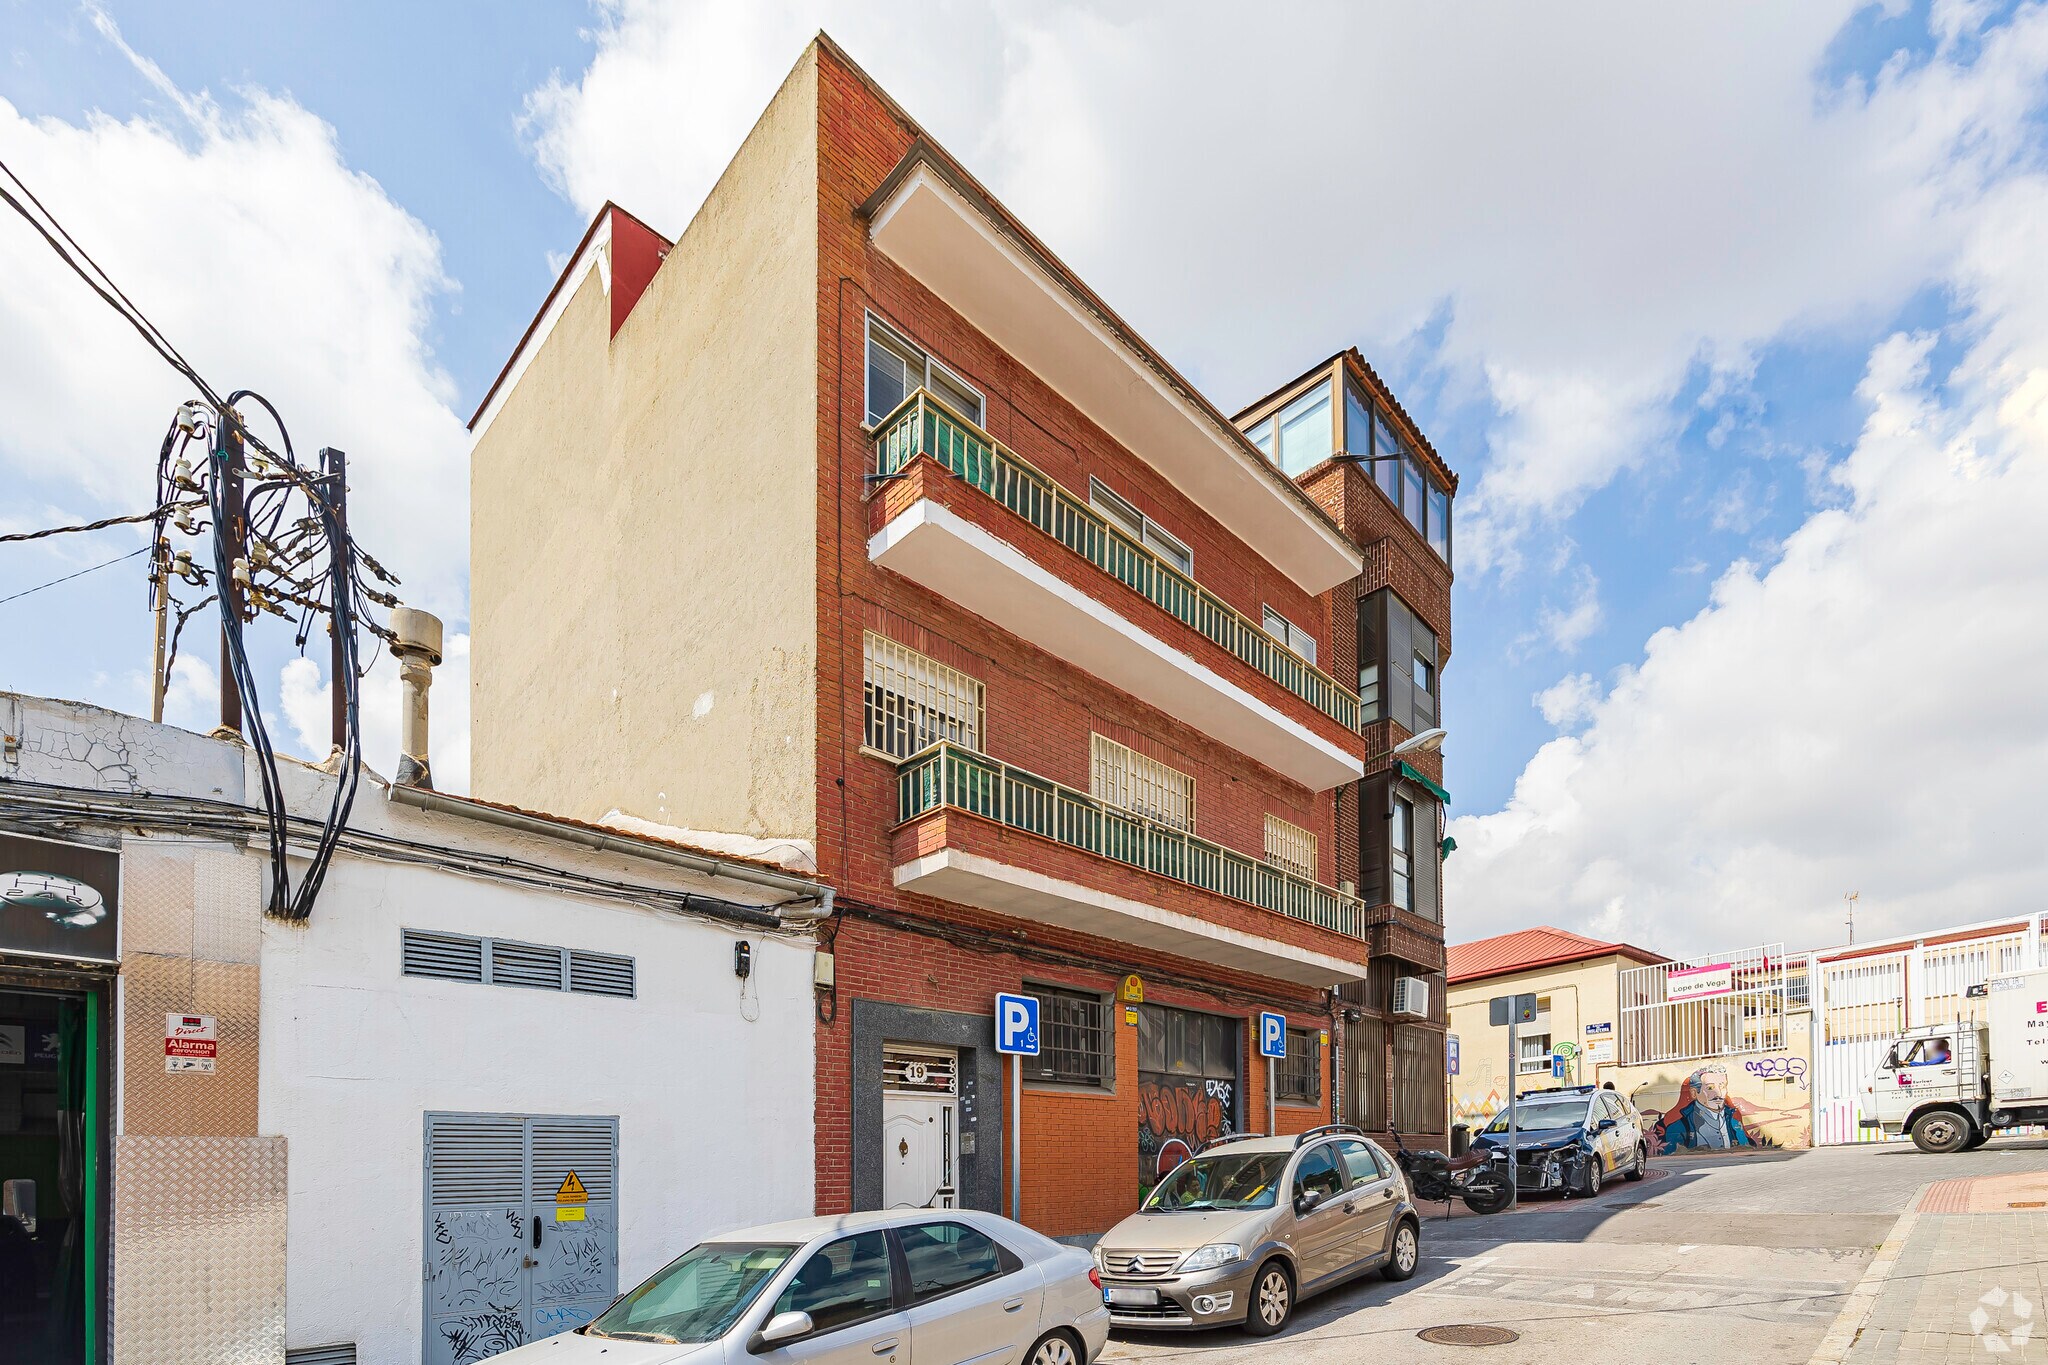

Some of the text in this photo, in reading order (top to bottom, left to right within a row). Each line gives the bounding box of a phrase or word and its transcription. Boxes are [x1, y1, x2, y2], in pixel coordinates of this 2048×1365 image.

[1673, 984, 1692, 993] Lope
[1706, 980, 1726, 988] Vega
[1004, 1000, 1030, 1047] P
[174, 1026, 211, 1036] Direct
[1265, 1017, 1281, 1051] P
[168, 1039, 215, 1051] Alarma
[1020, 1039, 1024, 1048] 1
[910, 1066, 924, 1079] 19
